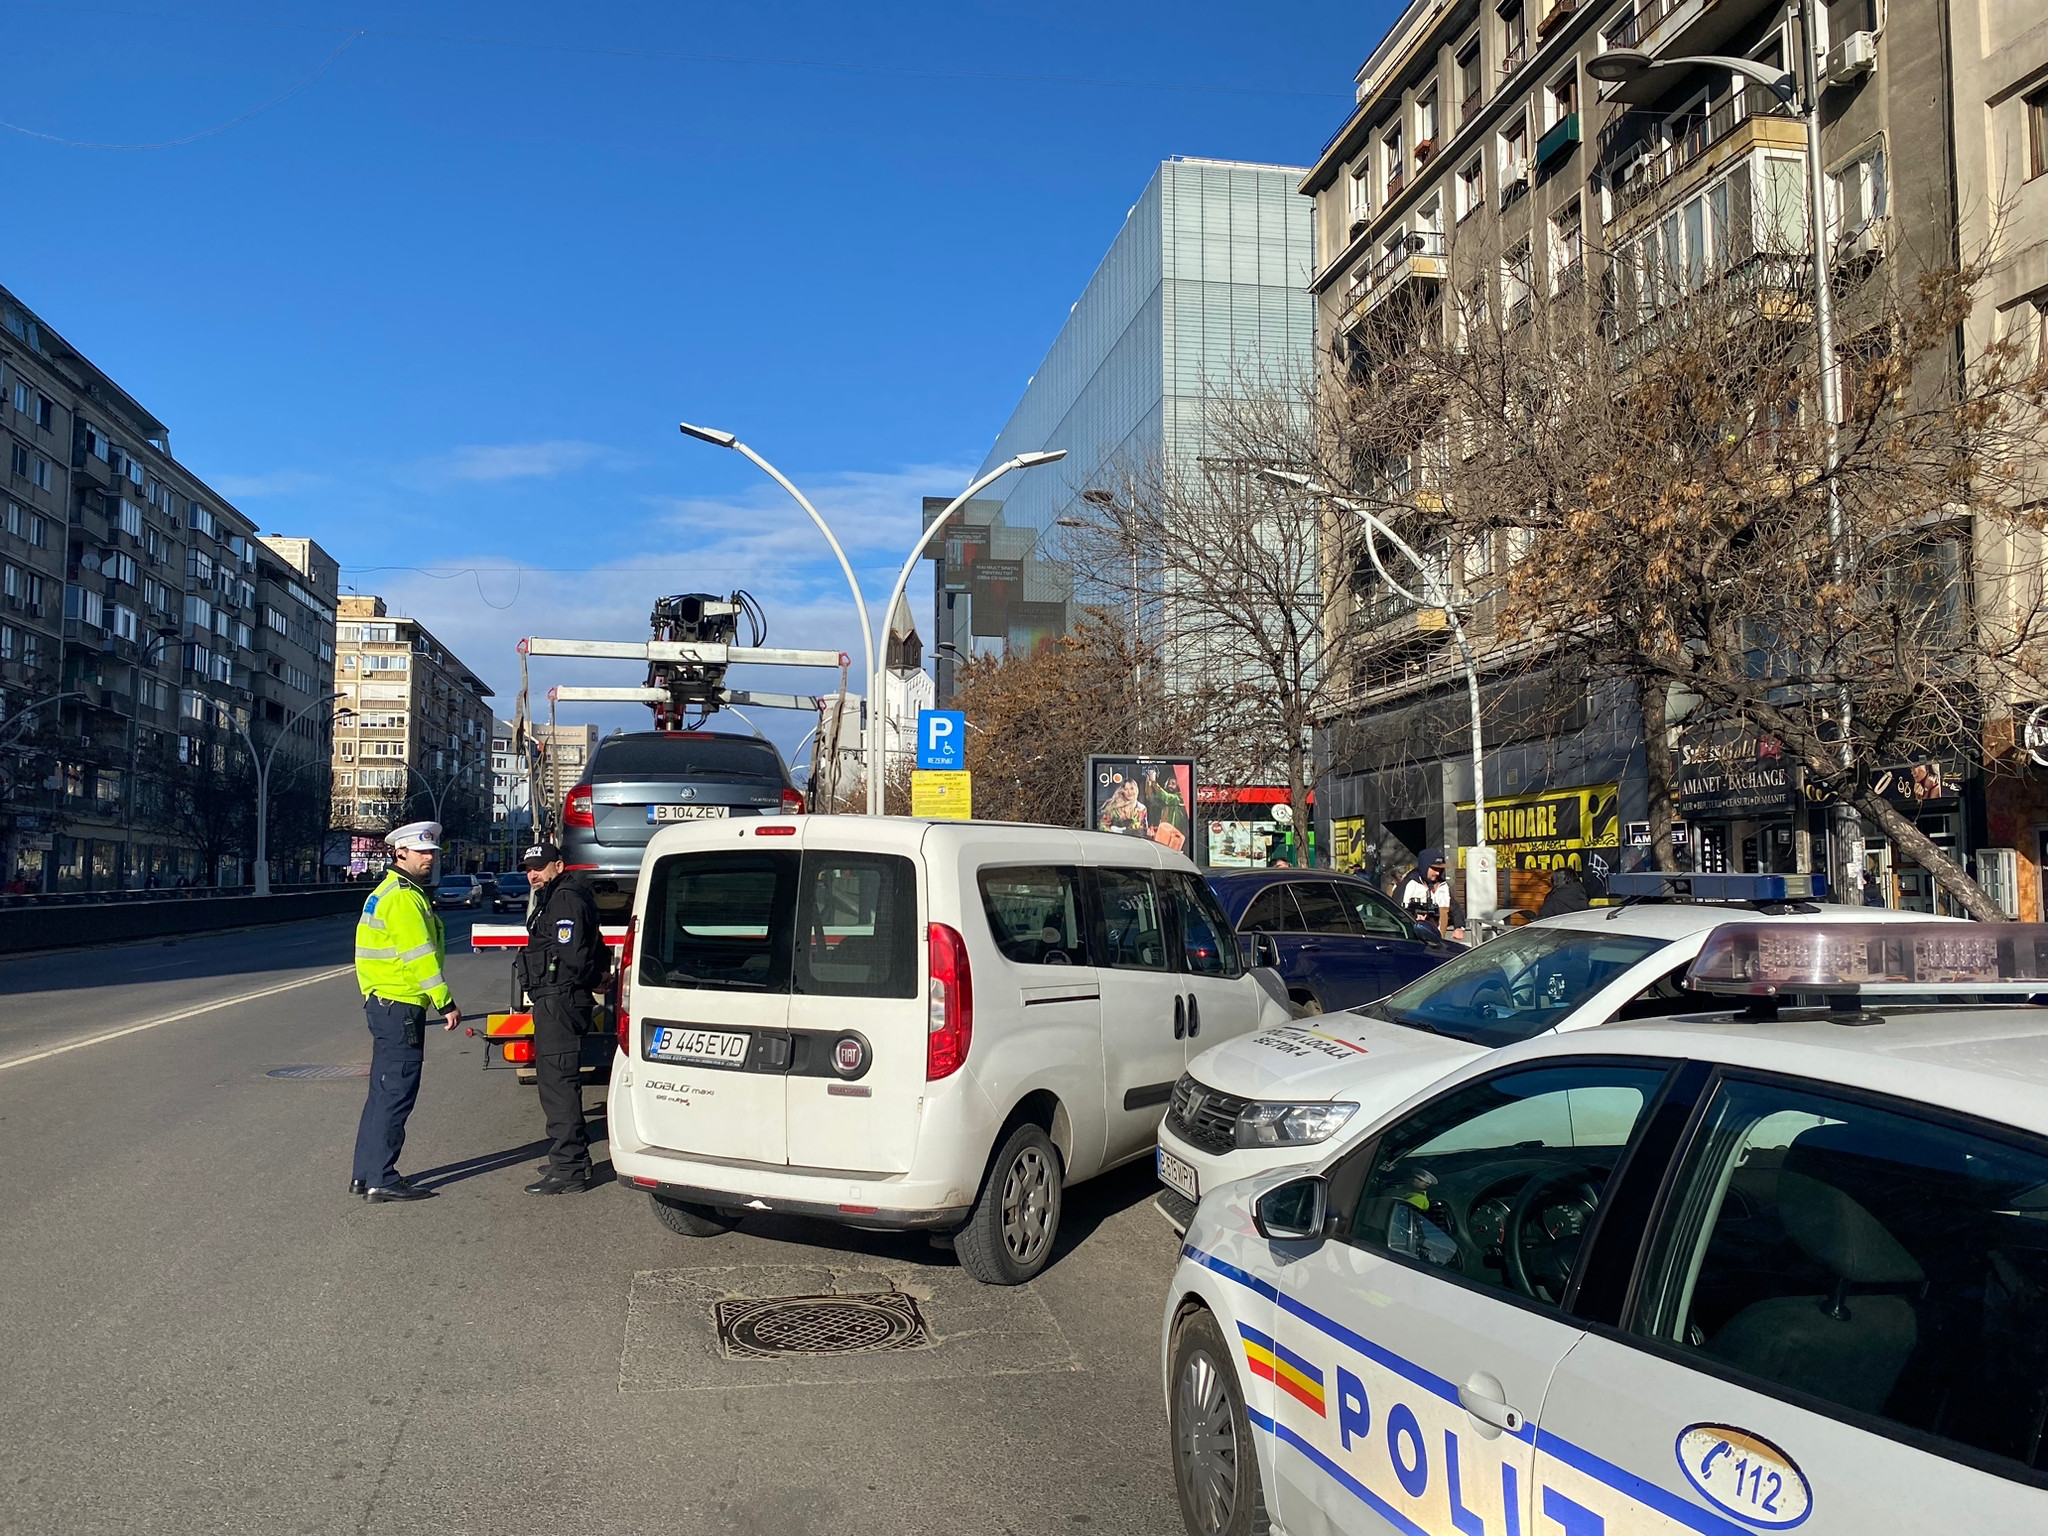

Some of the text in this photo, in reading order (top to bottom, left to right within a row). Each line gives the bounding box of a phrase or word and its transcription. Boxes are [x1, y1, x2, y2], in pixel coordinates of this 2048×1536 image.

[929, 717, 953, 750] P
[1099, 766, 1123, 788] glo
[1681, 769, 1786, 796] AMANET EXCHANGE
[1682, 801, 1694, 811] AUR
[1728, 796, 1753, 808] CEASURI
[1757, 793, 1786, 806] DIAMANTE
[658, 807, 725, 819] B 104 ZEV
[1484, 804, 1557, 841] ICHIDARE
[1634, 833, 1685, 844] AMET
[660, 1031, 673, 1050] B
[841, 1048, 857, 1063] FIAT
[645, 1080, 691, 1094] DOBLO
[1735, 1457, 1782, 1515] 112
